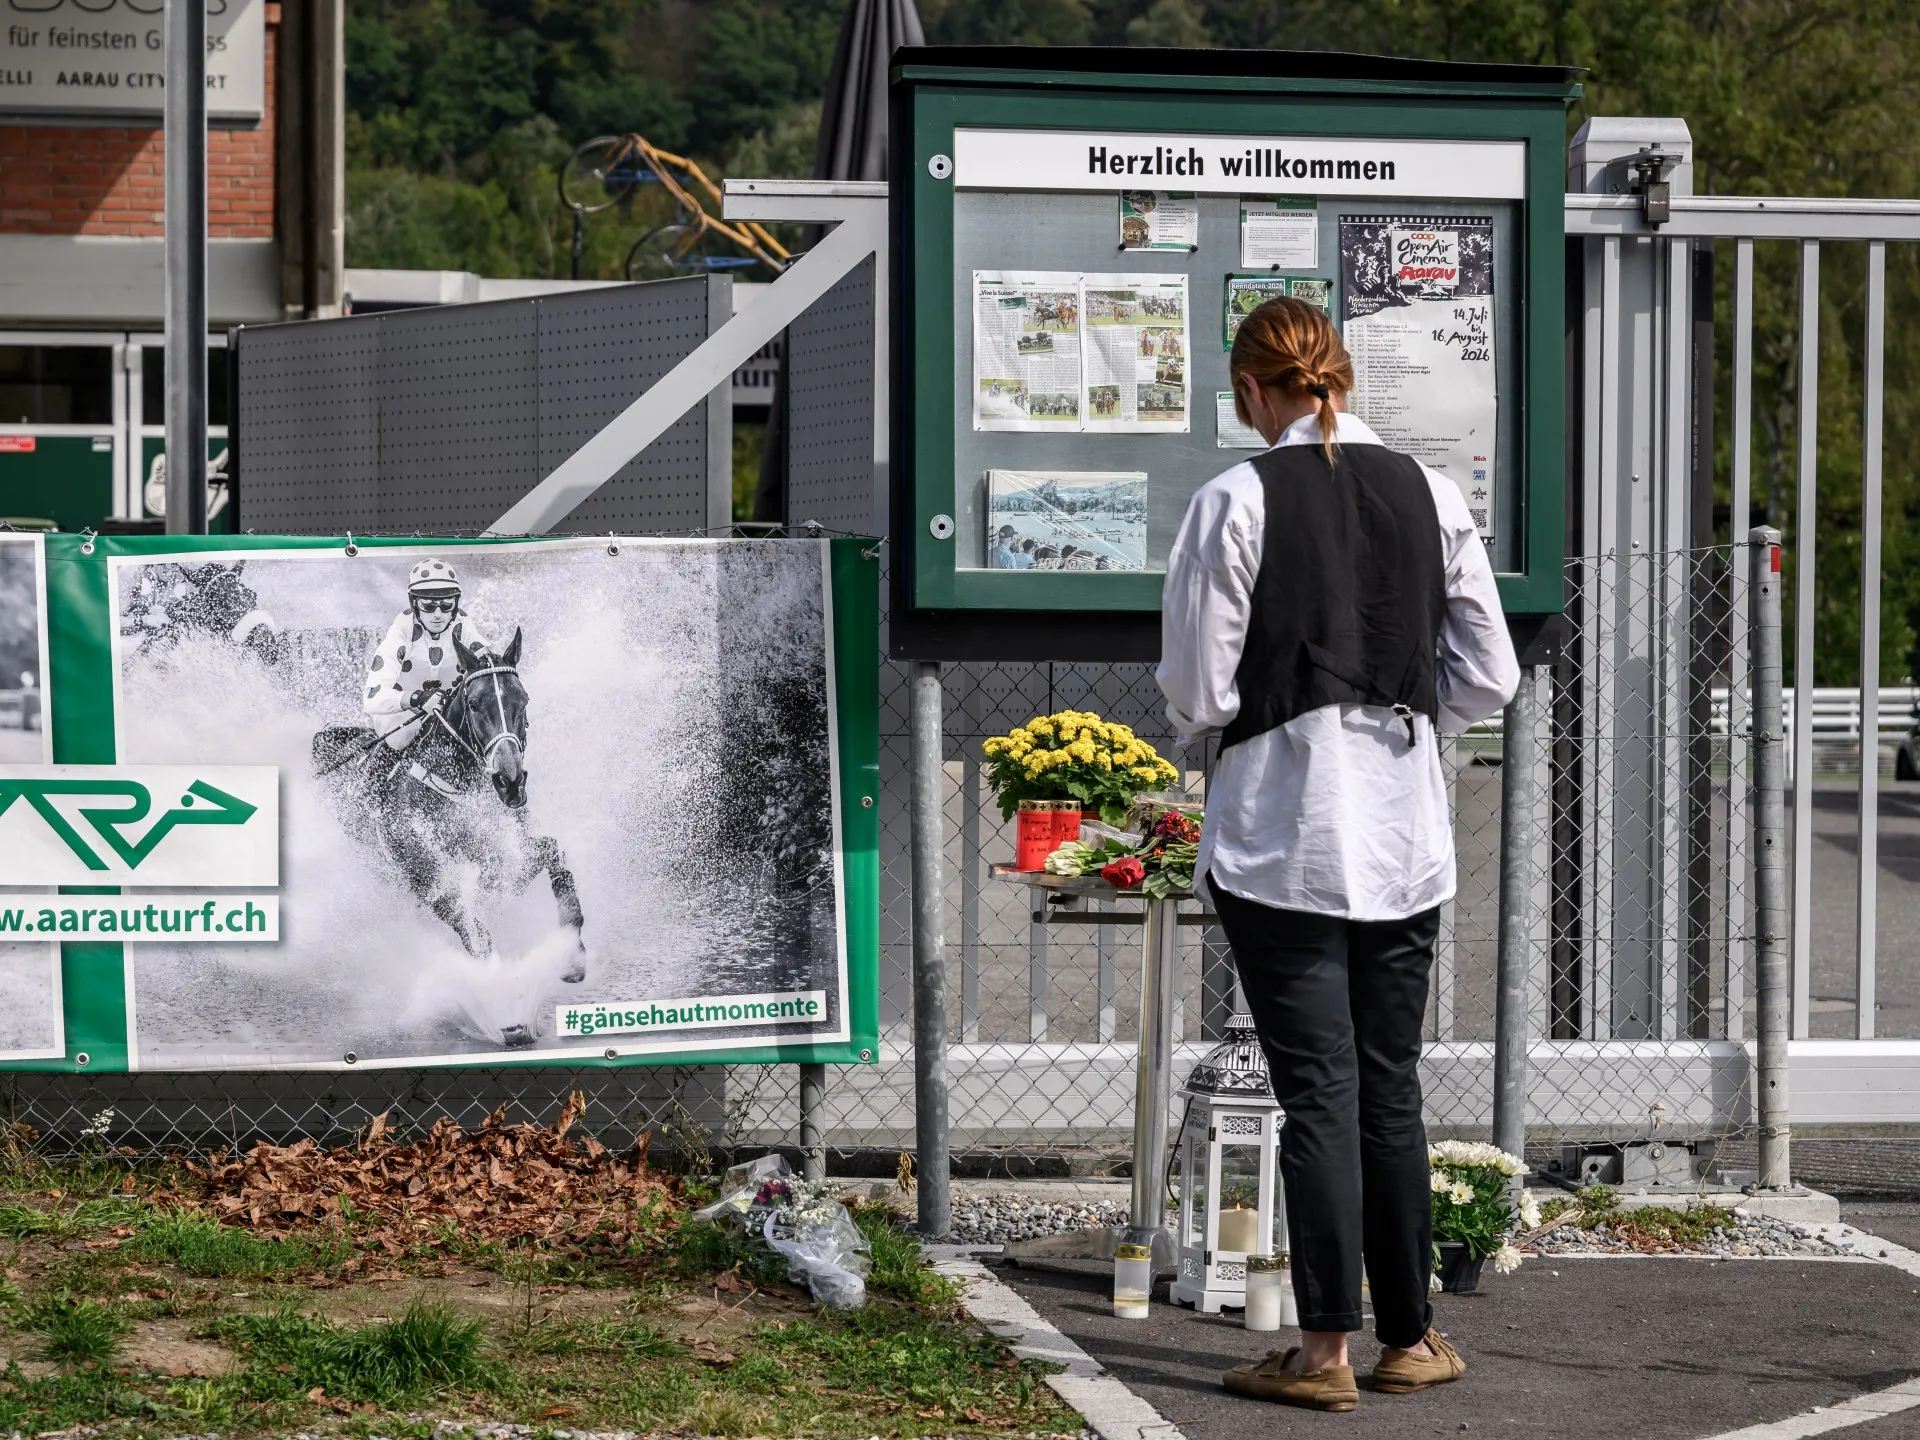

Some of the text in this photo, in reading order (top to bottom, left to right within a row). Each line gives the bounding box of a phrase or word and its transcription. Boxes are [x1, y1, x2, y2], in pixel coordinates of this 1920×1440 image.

[9, 25, 40, 47] für
[48, 27, 137, 49] feinsten
[56, 71, 119, 88] AARAU
[1088, 146, 1396, 181] Herzlich willkommen
[1411, 233, 1435, 241] coop
[1398, 251, 1453, 266] Cinema
[1399, 265, 1457, 280] Aarau
[1467, 306, 1488, 326] Juli
[1471, 324, 1482, 334] bis
[1432, 328, 1447, 343] 16.
[1445, 331, 1489, 348] August
[1461, 348, 1490, 361] 2026
[565, 996, 819, 1035] #gänsehautmomente
